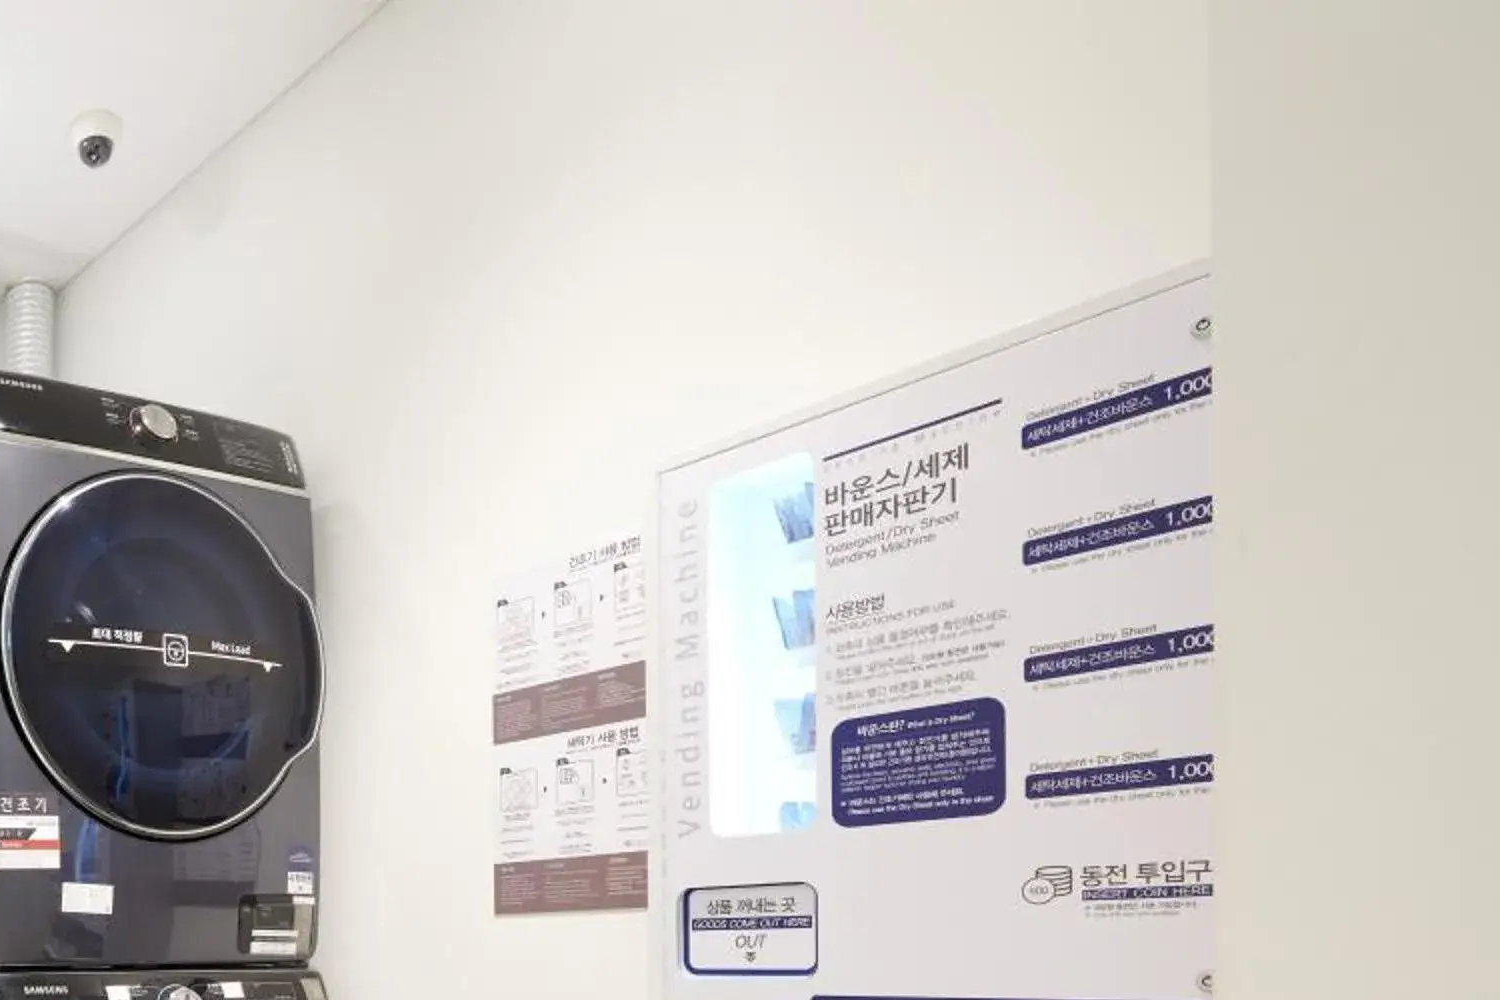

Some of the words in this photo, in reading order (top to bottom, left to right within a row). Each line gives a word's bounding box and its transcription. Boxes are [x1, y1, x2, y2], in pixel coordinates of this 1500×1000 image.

[824, 442, 969, 507] 바운스/세제
[825, 477, 957, 537] 판매자판기
[674, 498, 699, 662] Machine
[675, 680, 705, 840] Vending
[1080, 864, 1129, 887] 동전
[1136, 860, 1212, 883] 투입구
[735, 934, 768, 949] OUT
